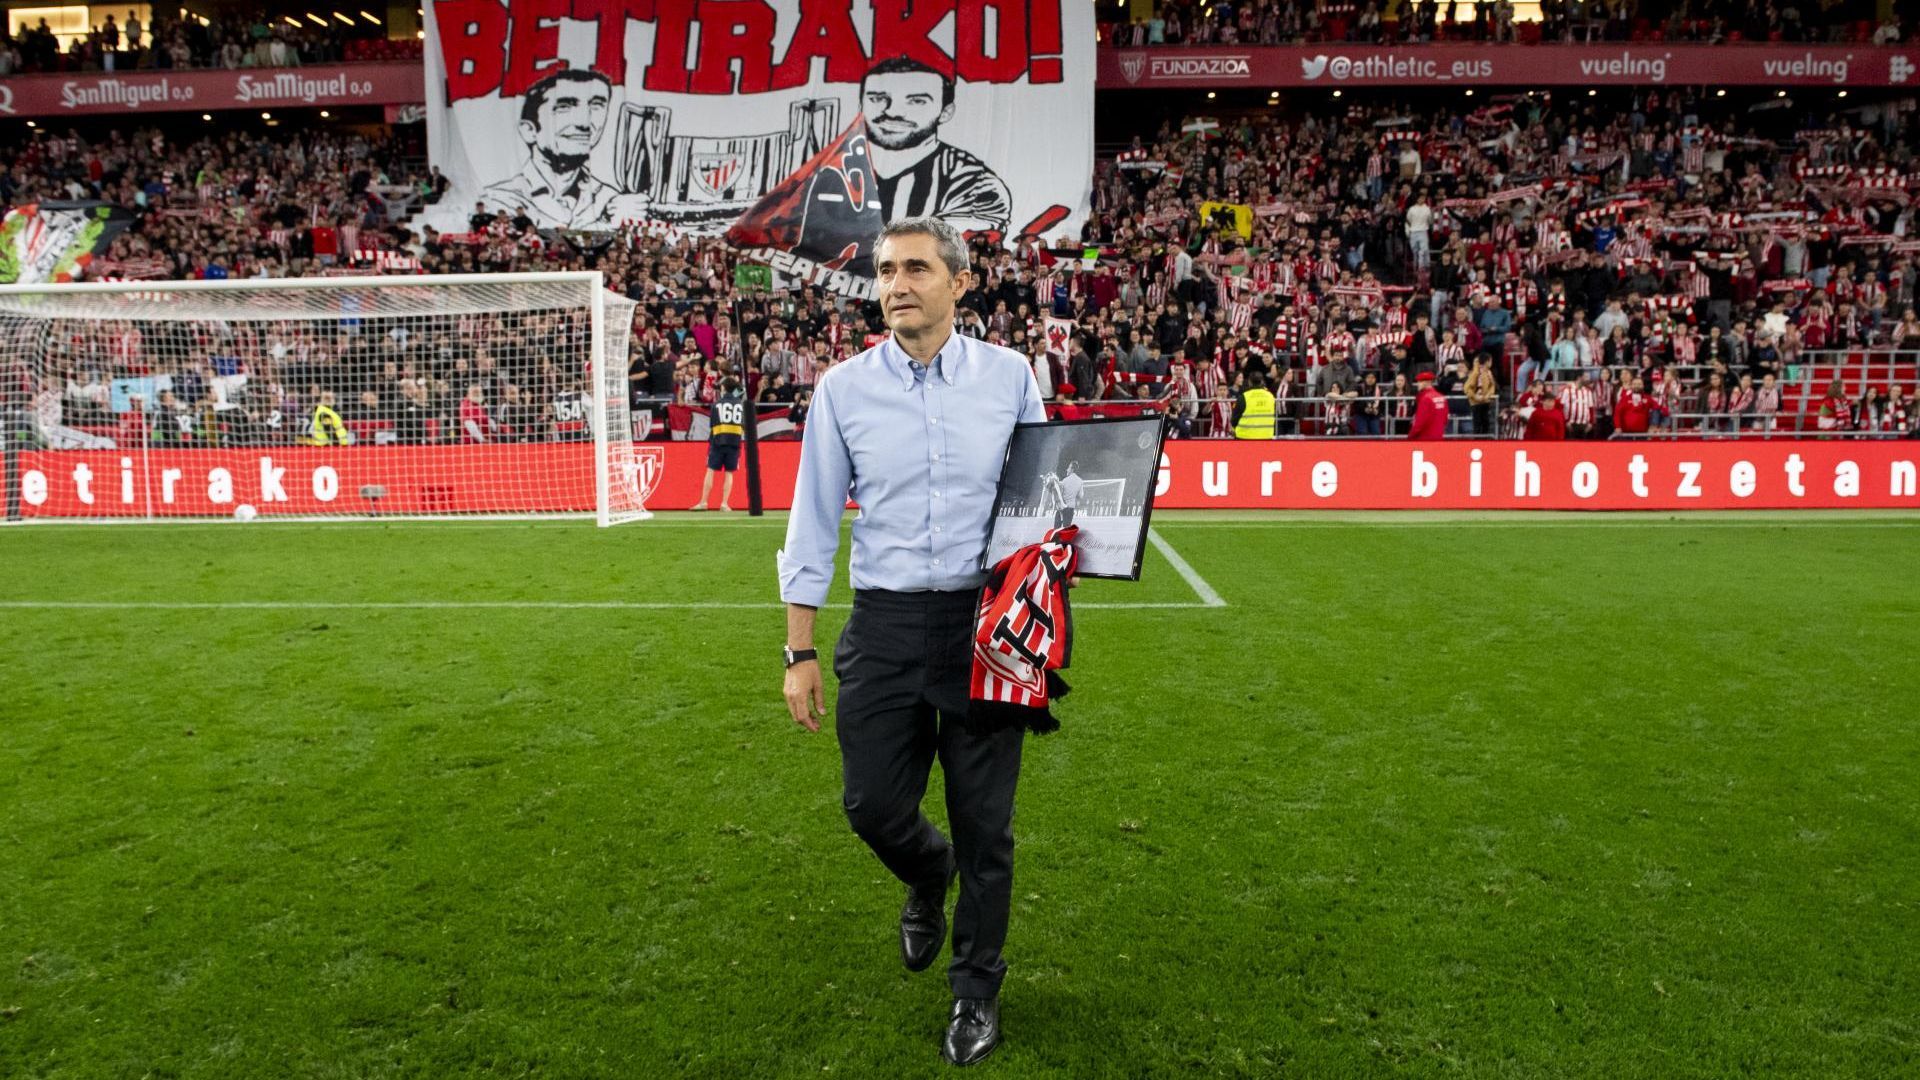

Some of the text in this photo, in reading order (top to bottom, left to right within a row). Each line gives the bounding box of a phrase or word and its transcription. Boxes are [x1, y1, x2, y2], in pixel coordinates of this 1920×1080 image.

[435, 0, 1063, 107] BETIRAKO!
[1152, 60, 1249, 74] FUNDAZIOA
[1329, 54, 1492, 79] @athletic_eus
[1580, 52, 1667, 81] vueling
[1764, 54, 1848, 82] vueling
[715, 402, 743, 424] 166
[22, 457, 338, 505] etirako
[1411, 448, 1918, 498] bihotzetan
